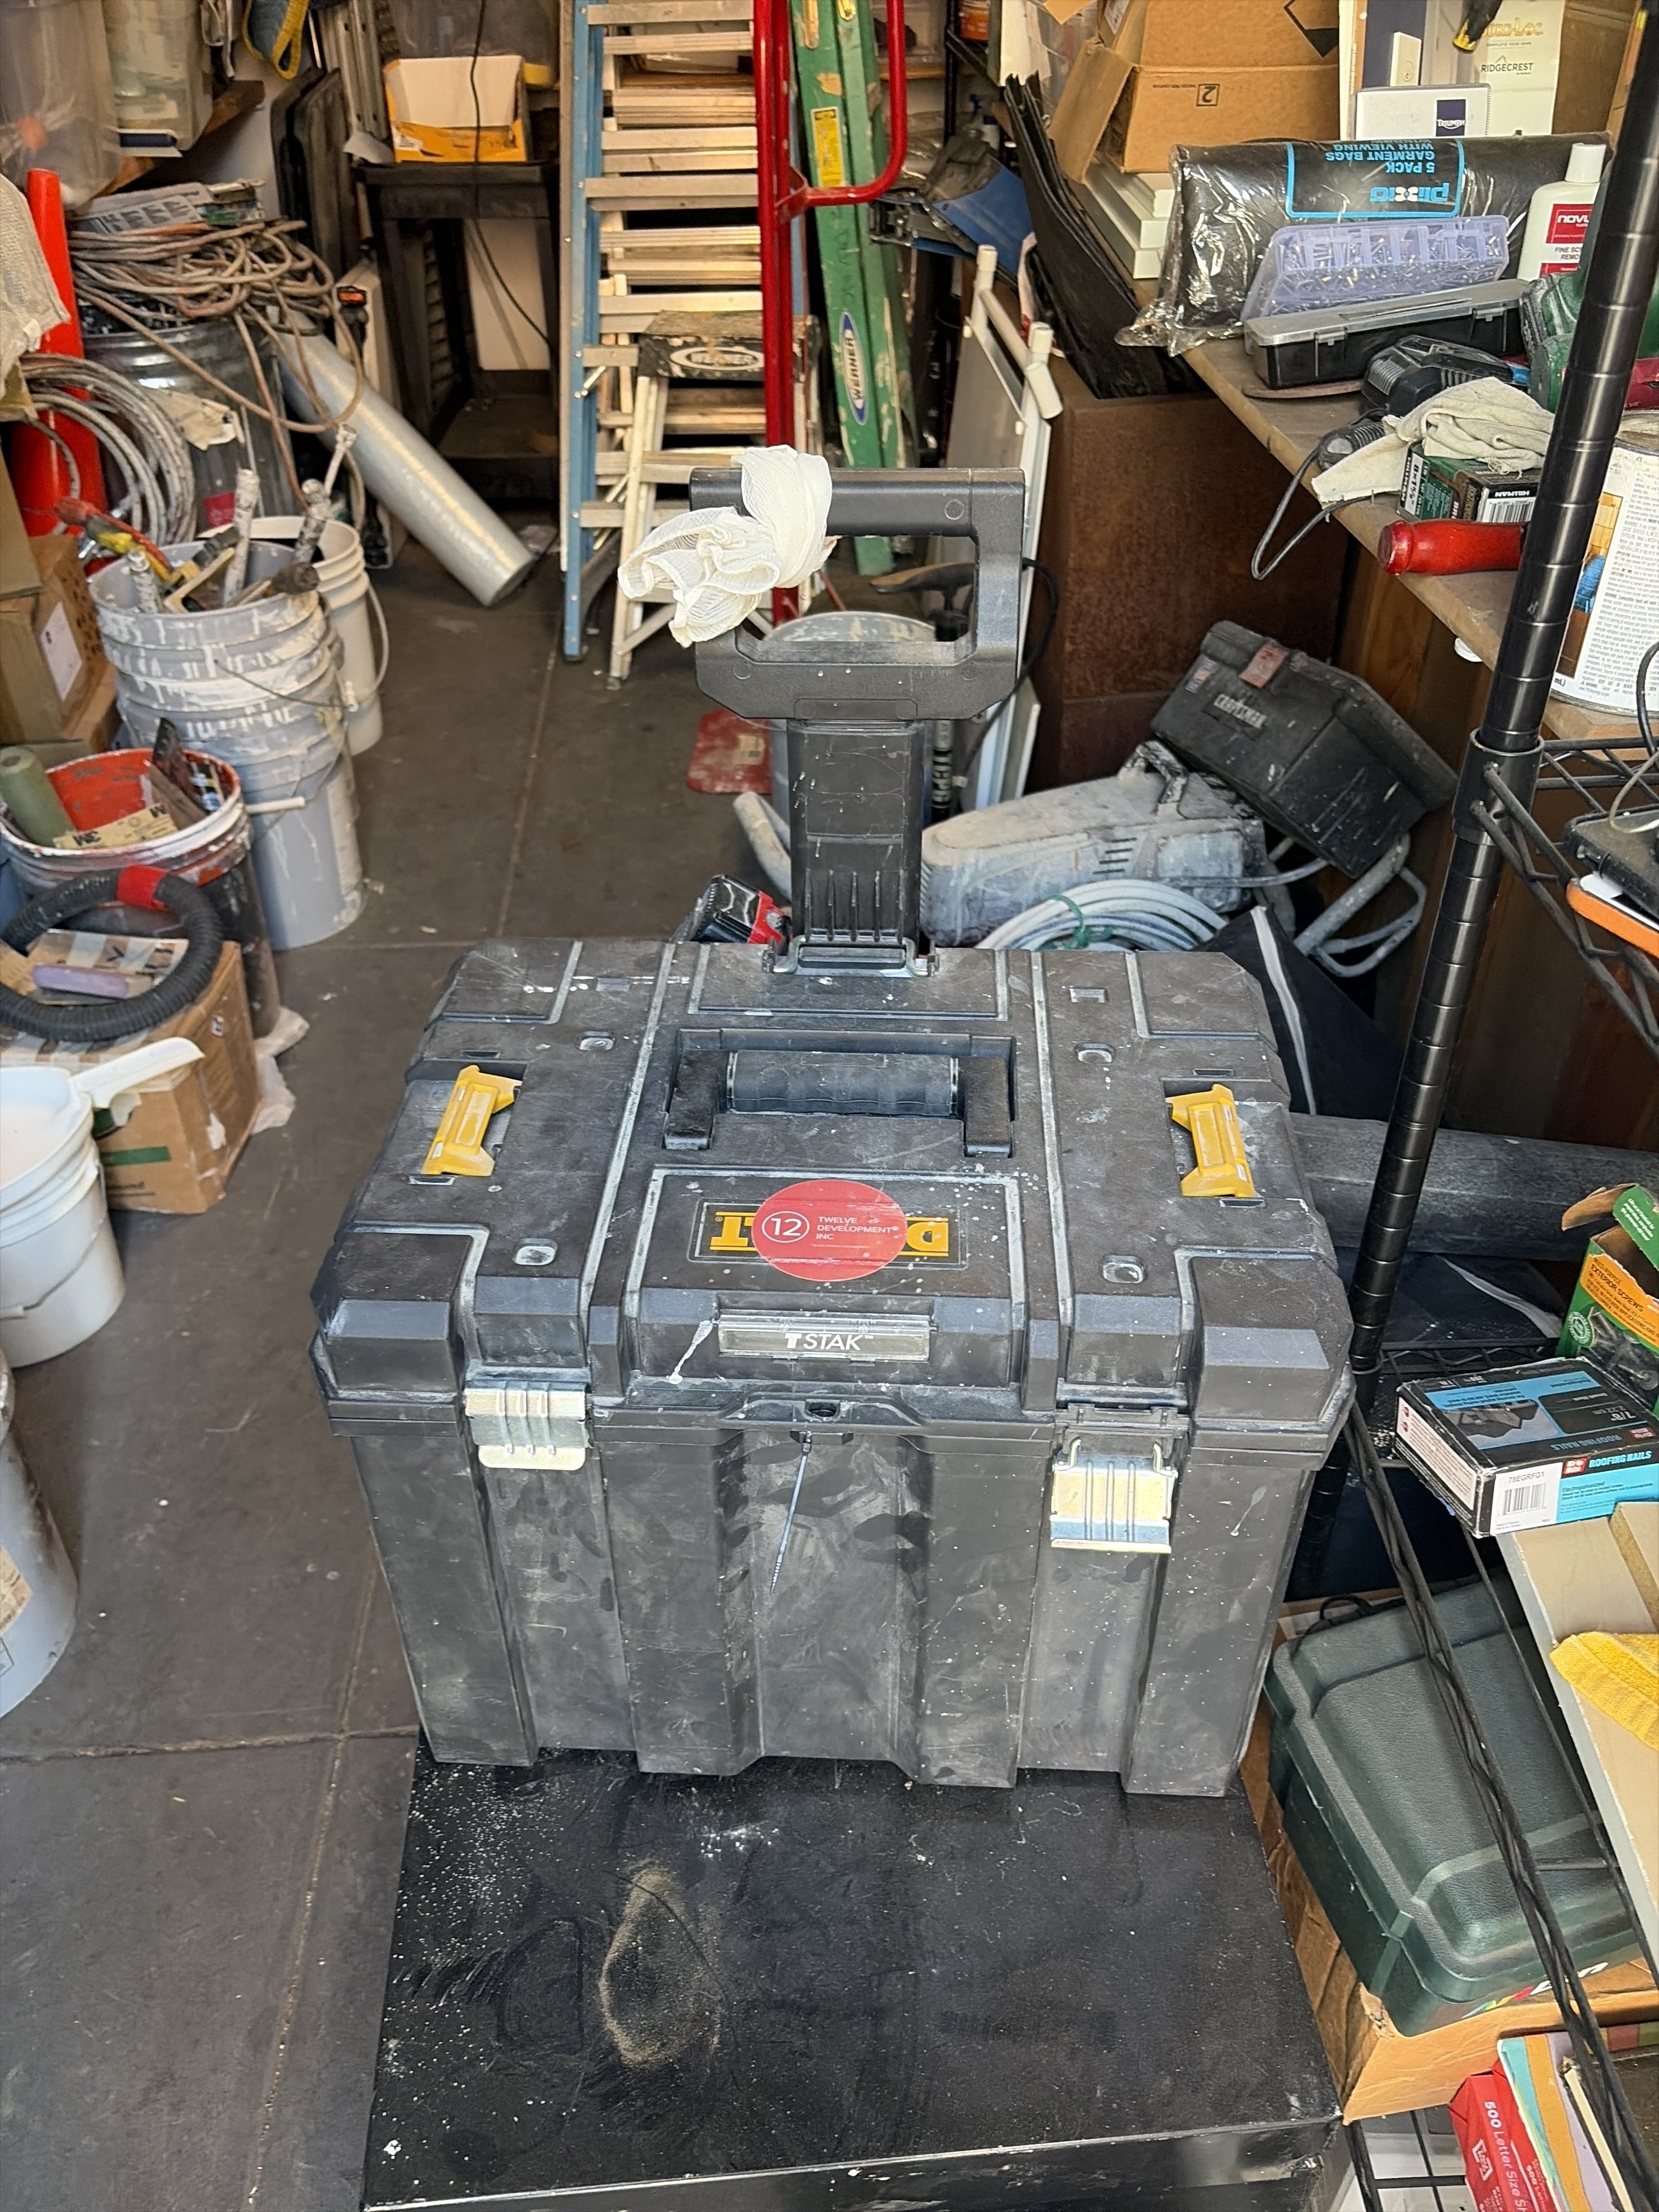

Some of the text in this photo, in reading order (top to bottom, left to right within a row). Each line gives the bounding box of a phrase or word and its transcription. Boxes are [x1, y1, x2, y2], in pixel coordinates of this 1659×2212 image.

[1481, 63, 1533, 72] RIDGECREST
[1202, 86, 1216, 103] 2
[1325, 151, 1435, 161] GARMENT BAGS
[1385, 161, 1436, 173] 5 PACK
[845, 336, 862, 400] WERNER
[771, 1217, 802, 1237] 12
[818, 1216, 858, 1224] TWELVE
[816, 1224, 893, 1234] DEVELOPMENT
[1591, 1263, 1644, 1312] EXTERIOR SCREWS
[1550, 1434, 1623, 1451] ROOFING NAILS
[1588, 1454, 1626, 1468] ROOFING
[1626, 1451, 1652, 1462] NAILS
[1484, 2101, 1502, 2128] 500
[1493, 2131, 1513, 2169] Letter
[1506, 2170, 1521, 2197] Size
